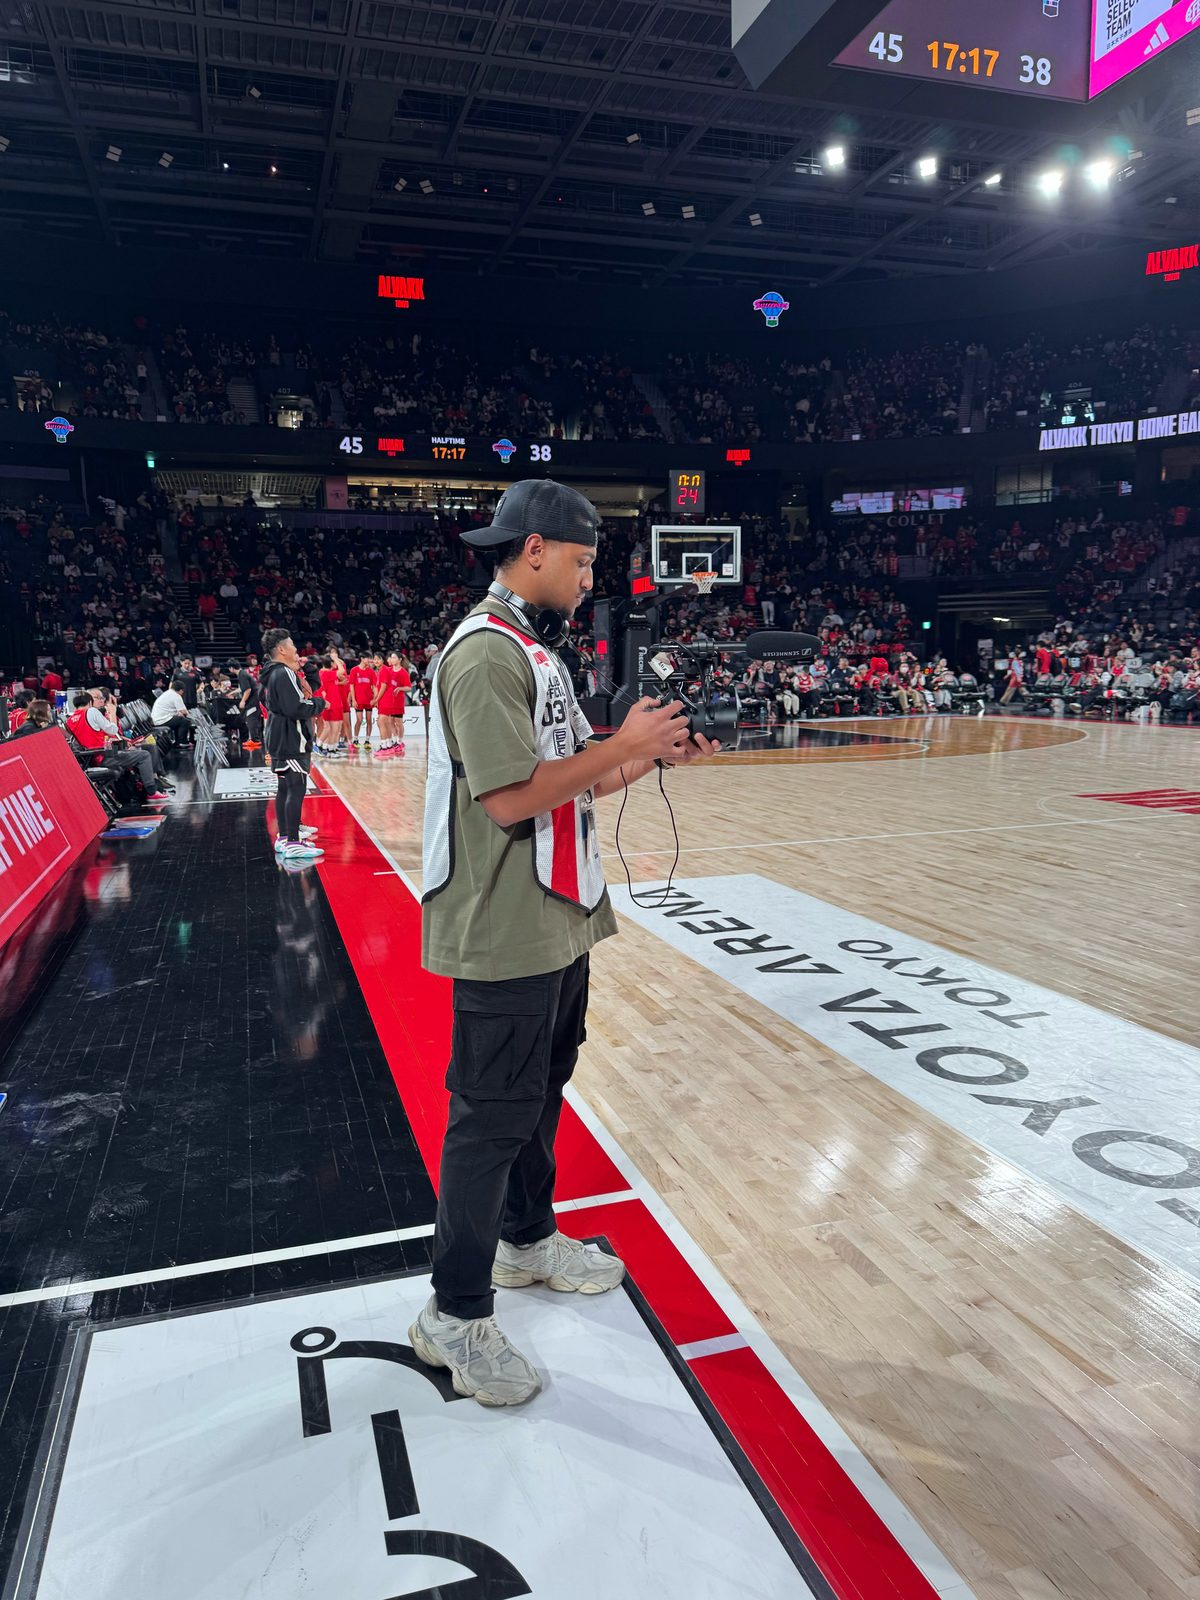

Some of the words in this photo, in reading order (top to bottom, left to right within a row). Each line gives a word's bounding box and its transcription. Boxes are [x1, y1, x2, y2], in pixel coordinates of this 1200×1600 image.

[1106, 10, 1131, 40] TEAM
[1107, 0, 1139, 24] SELEC
[868, 31, 903, 63] 45
[927, 40, 1000, 77] 17:17
[1019, 54, 1051, 86] 38
[339, 436, 363, 454] 45
[431, 436, 466, 445] HALFTIME
[1039, 425, 1088, 451] ALVARK
[1089, 420, 1134, 446] TOKYO
[1137, 414, 1178, 441] HOME
[1178, 411, 1200, 434] GA
[432, 447, 466, 460] 17:17
[530, 444, 552, 462] 38
[678, 487, 698, 505] 24
[541, 698, 567, 727] 03
[0, 784, 55, 876] TIME
[631, 886, 844, 975] ARENA
[838, 939, 1051, 1029] TOKYO
[820, 987, 1200, 1228] OYOTA
